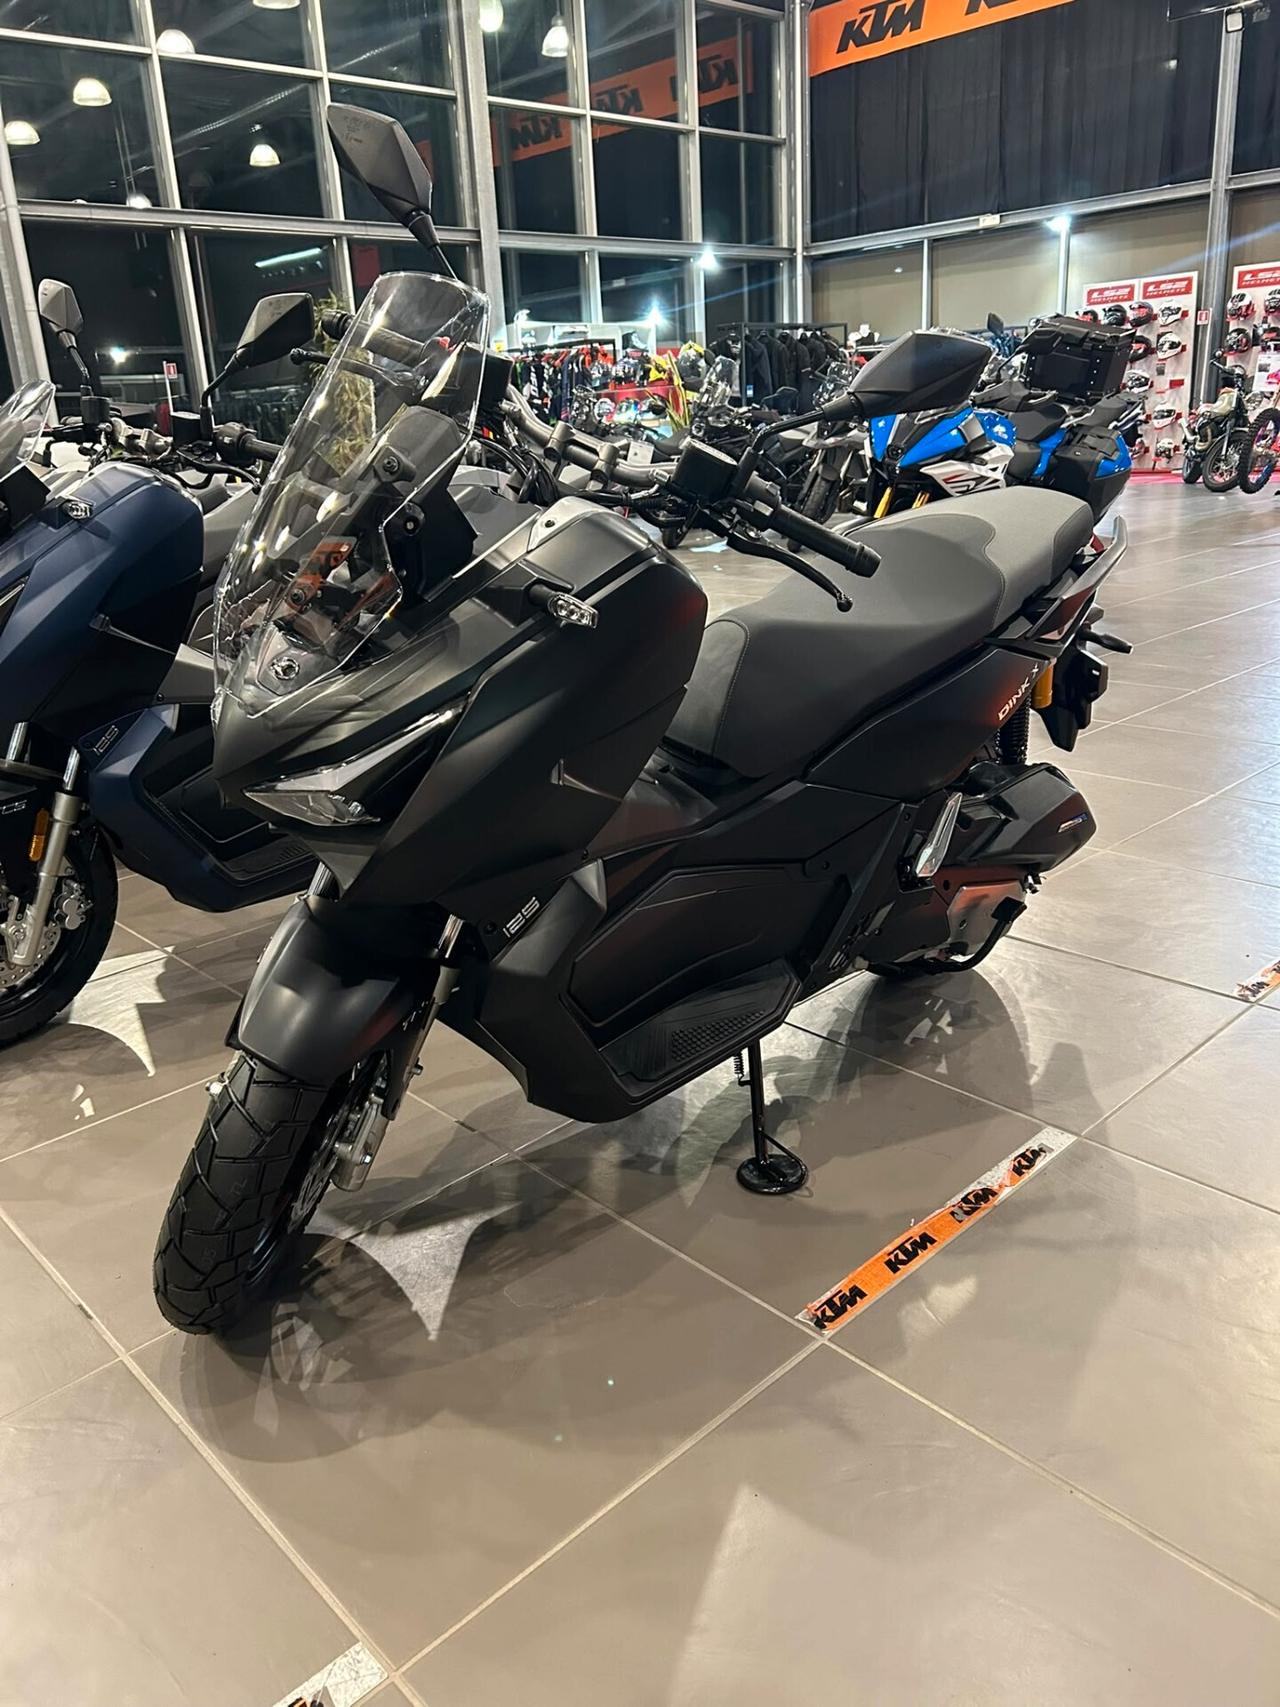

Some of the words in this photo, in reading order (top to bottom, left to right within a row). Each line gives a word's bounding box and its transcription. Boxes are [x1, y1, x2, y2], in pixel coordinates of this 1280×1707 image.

[836, 0, 925, 54] KTM
[1091, 288, 1131, 298] LS2
[1147, 281, 1189, 292] LS2
[998, 676, 1030, 721] DINK
[93, 725, 119, 756] 125
[0, 800, 27, 814] CS
[502, 896, 540, 938] 125
[884, 1231, 937, 1275] KTM
[813, 1285, 868, 1330] KTM
